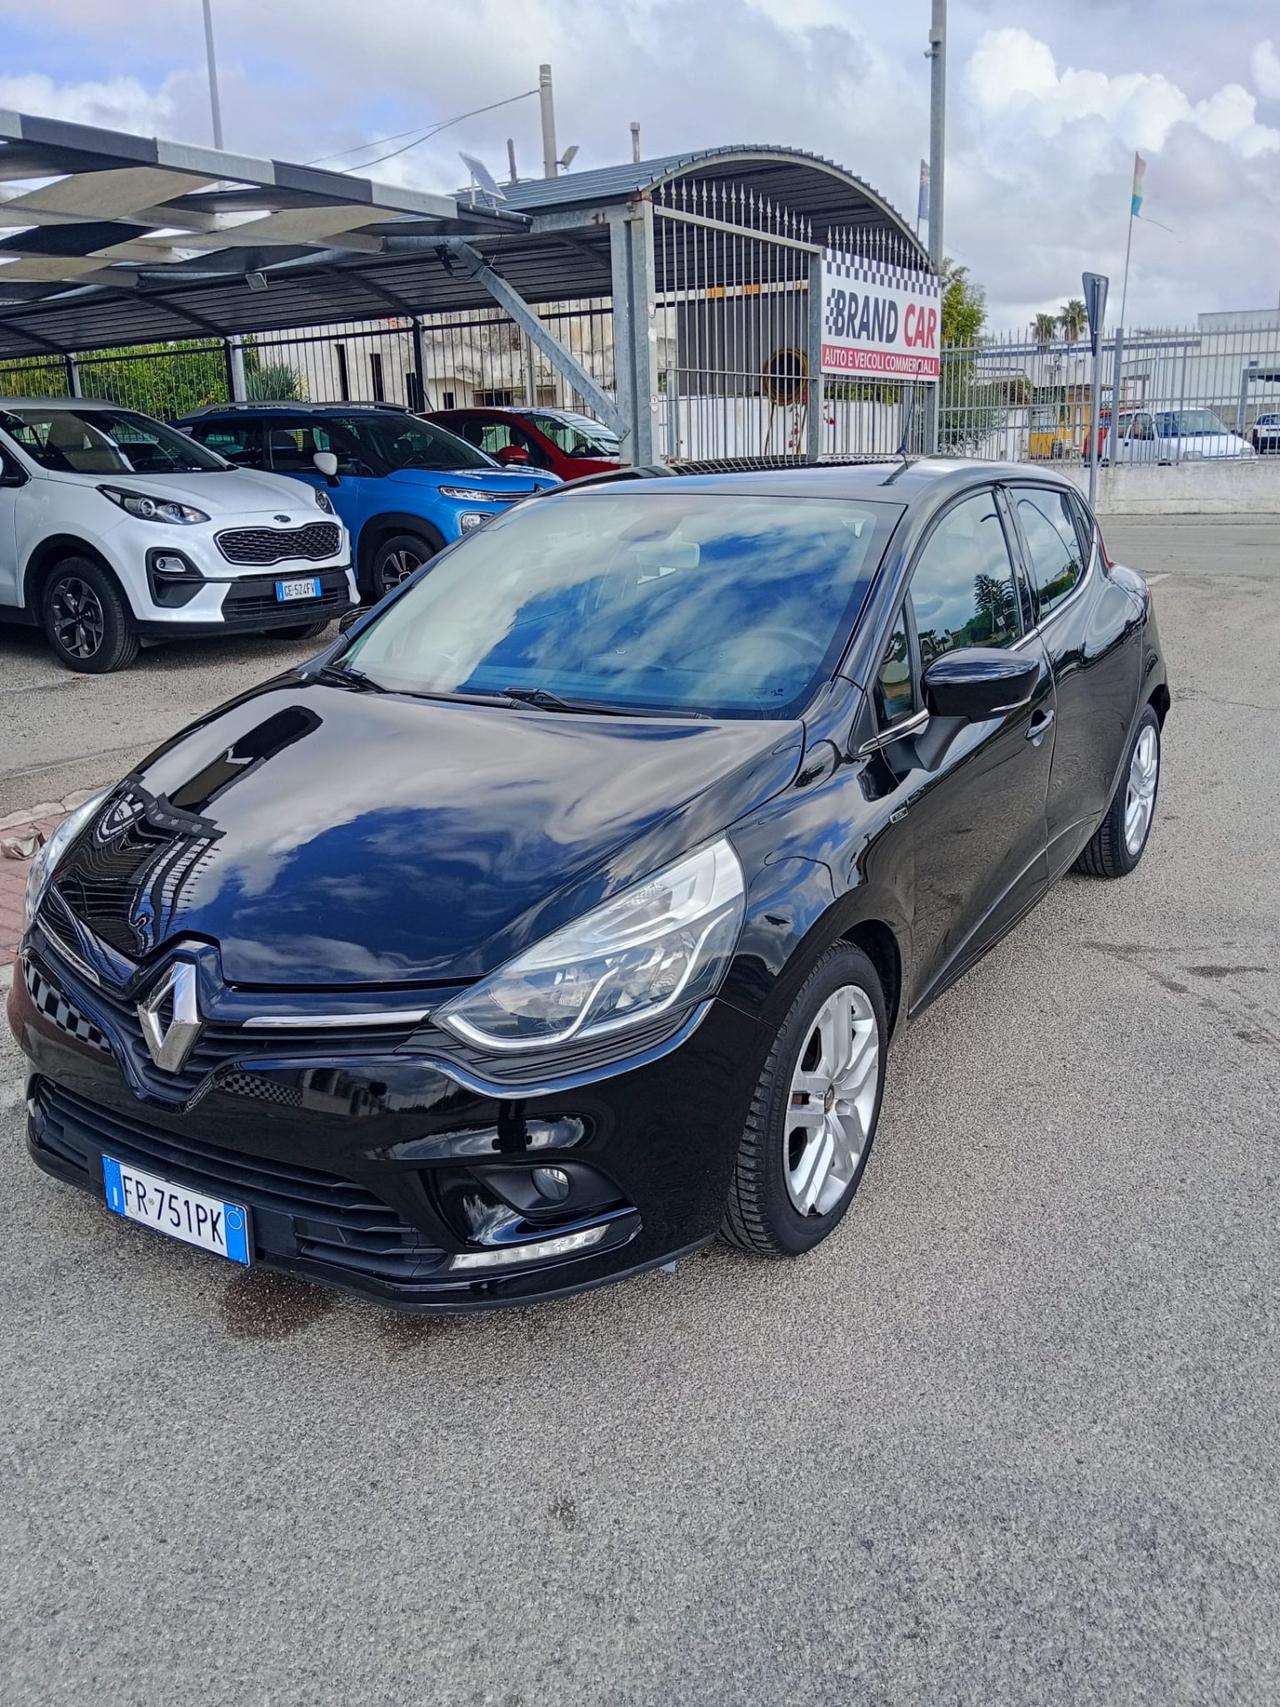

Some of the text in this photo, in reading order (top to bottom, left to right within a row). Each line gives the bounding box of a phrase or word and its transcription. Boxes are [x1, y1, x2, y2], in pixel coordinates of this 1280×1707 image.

[826, 288, 936, 349] BRAND CAR
[825, 348, 935, 373] AUTO E VEICOLI COMMERCIALI
